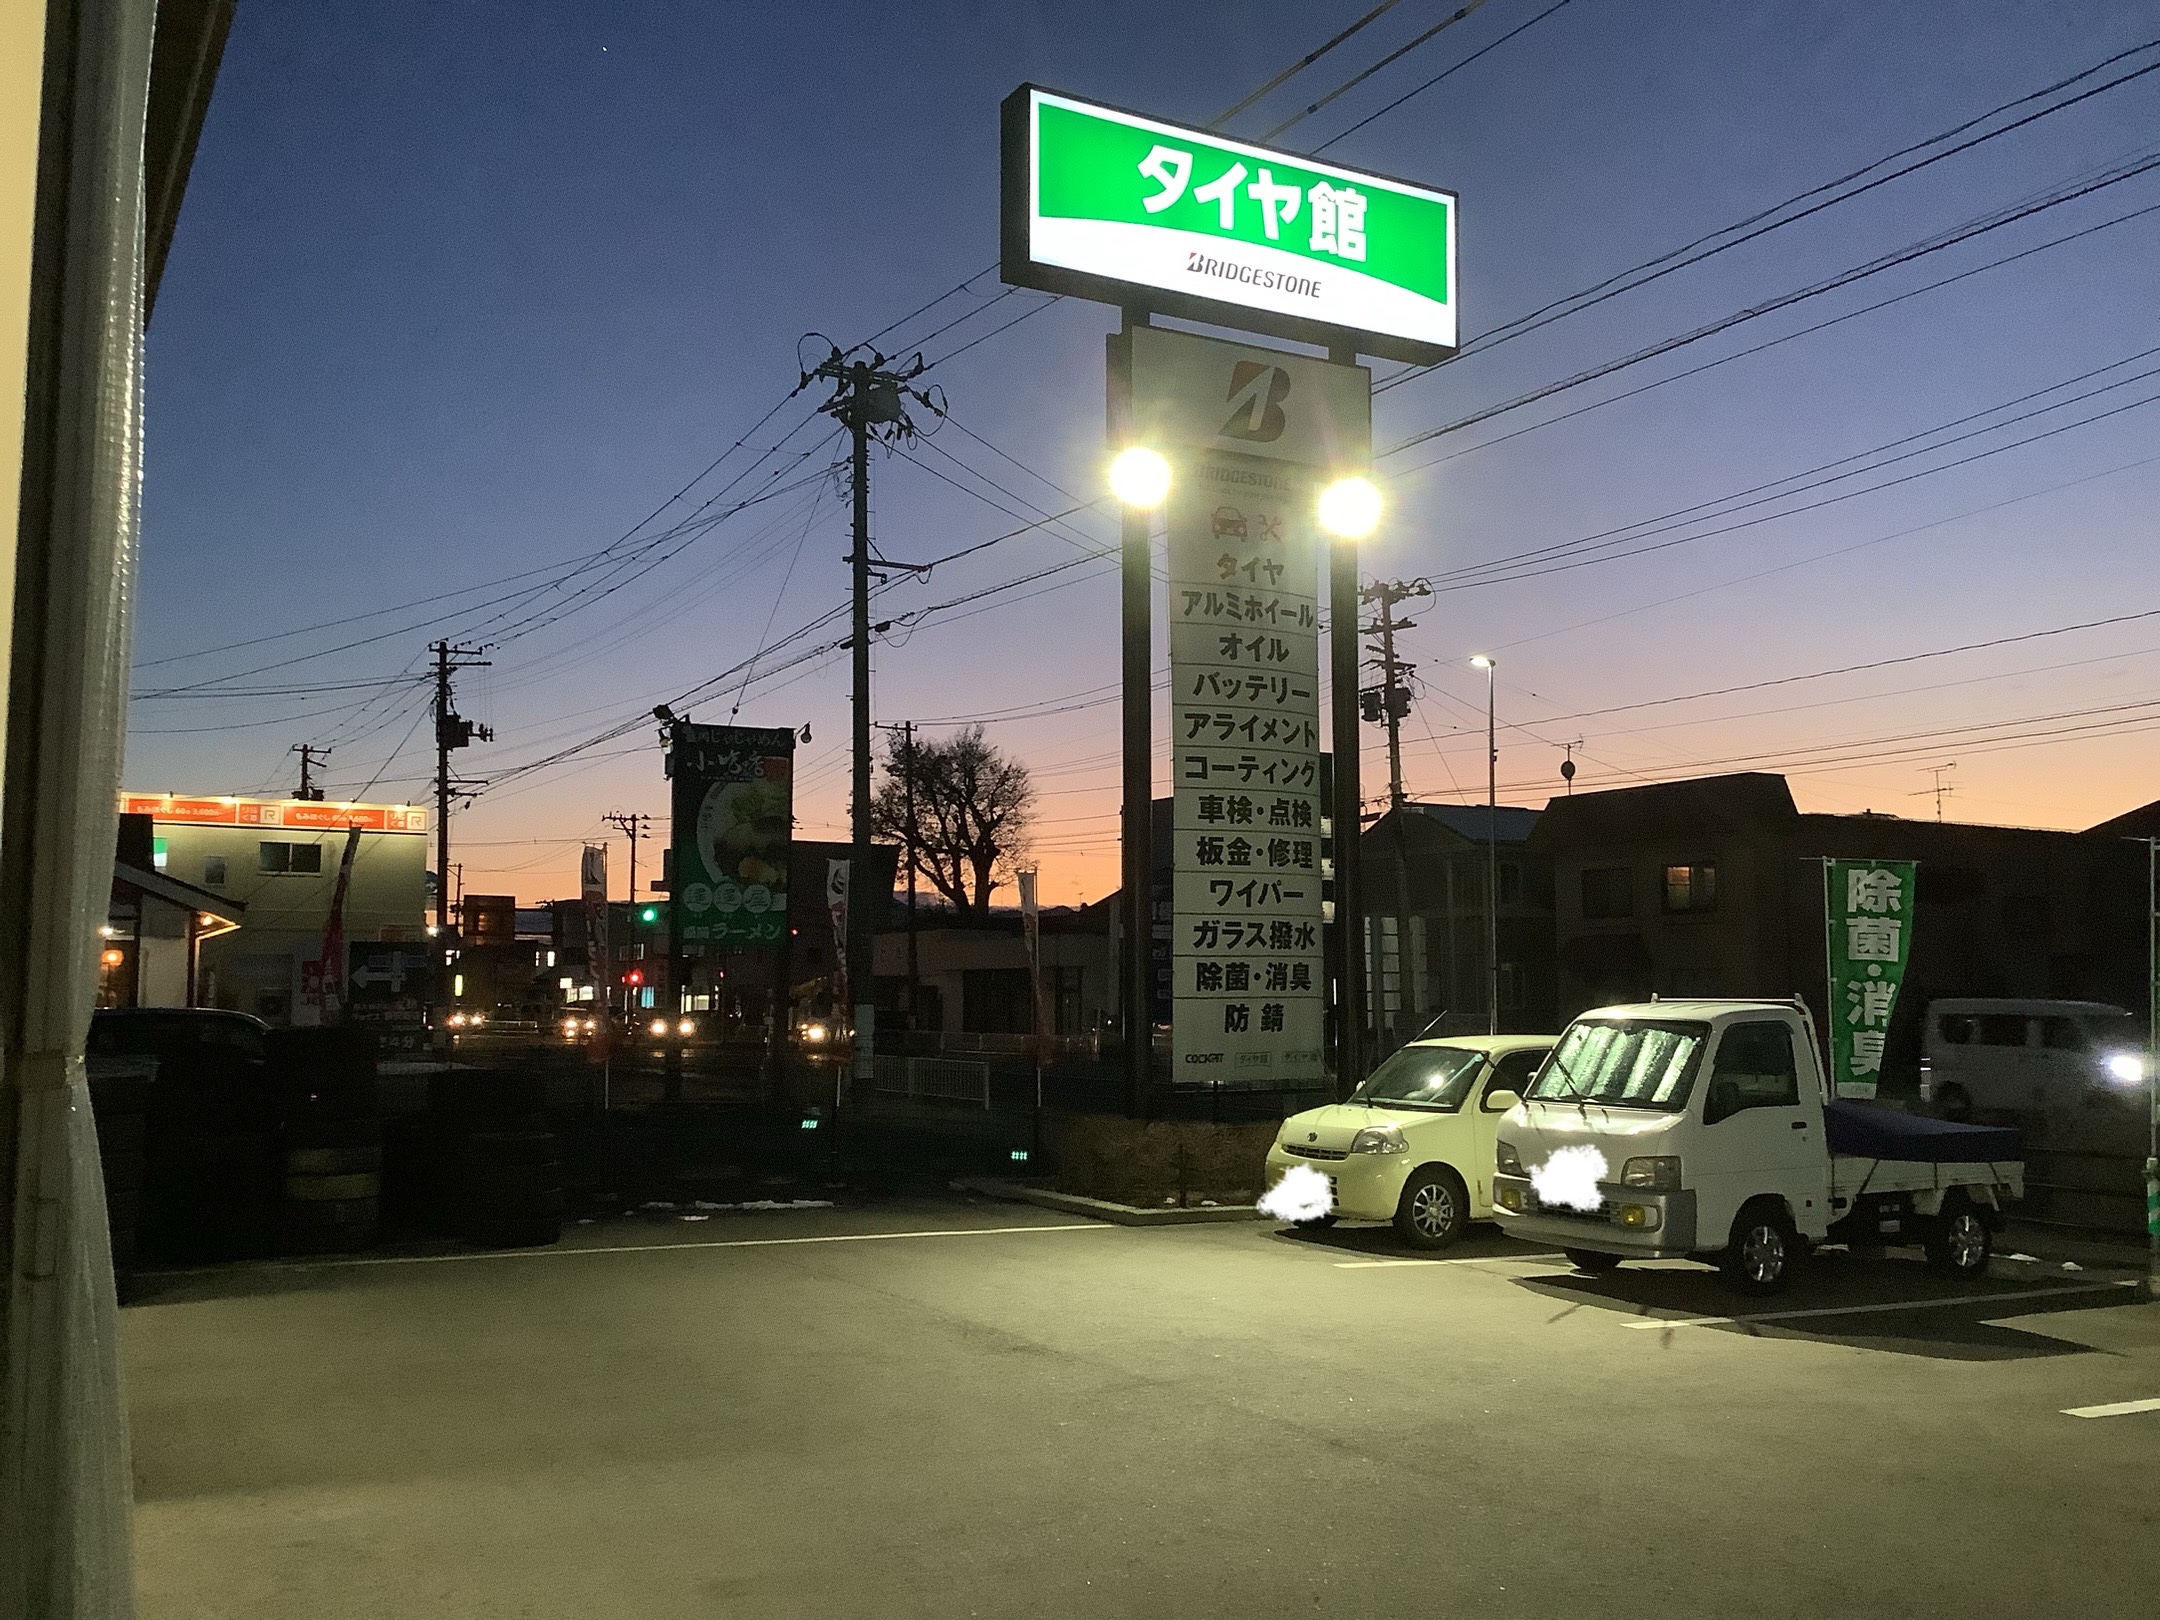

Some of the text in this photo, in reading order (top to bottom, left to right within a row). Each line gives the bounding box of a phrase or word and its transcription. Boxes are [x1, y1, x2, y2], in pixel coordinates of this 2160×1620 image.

[1137, 144, 1368, 263] タイヤ館
[1186, 251, 1322, 299] BRIDGESTONE
[1217, 553, 1284, 585] タイヤ
[1181, 590, 1314, 628] アルミホイール
[1219, 632, 1290, 662] オイル
[1192, 671, 1311, 704] バッテリー
[1184, 713, 1316, 748] アライメント
[1185, 755, 1316, 788] コーティング
[1197, 794, 1313, 828] 車検・点検
[1196, 836, 1313, 869] 板金・修理
[1210, 879, 1304, 908] ワイパー
[1193, 919, 1316, 950] ガラス撥水
[1196, 962, 1312, 992] 除菌・消臭
